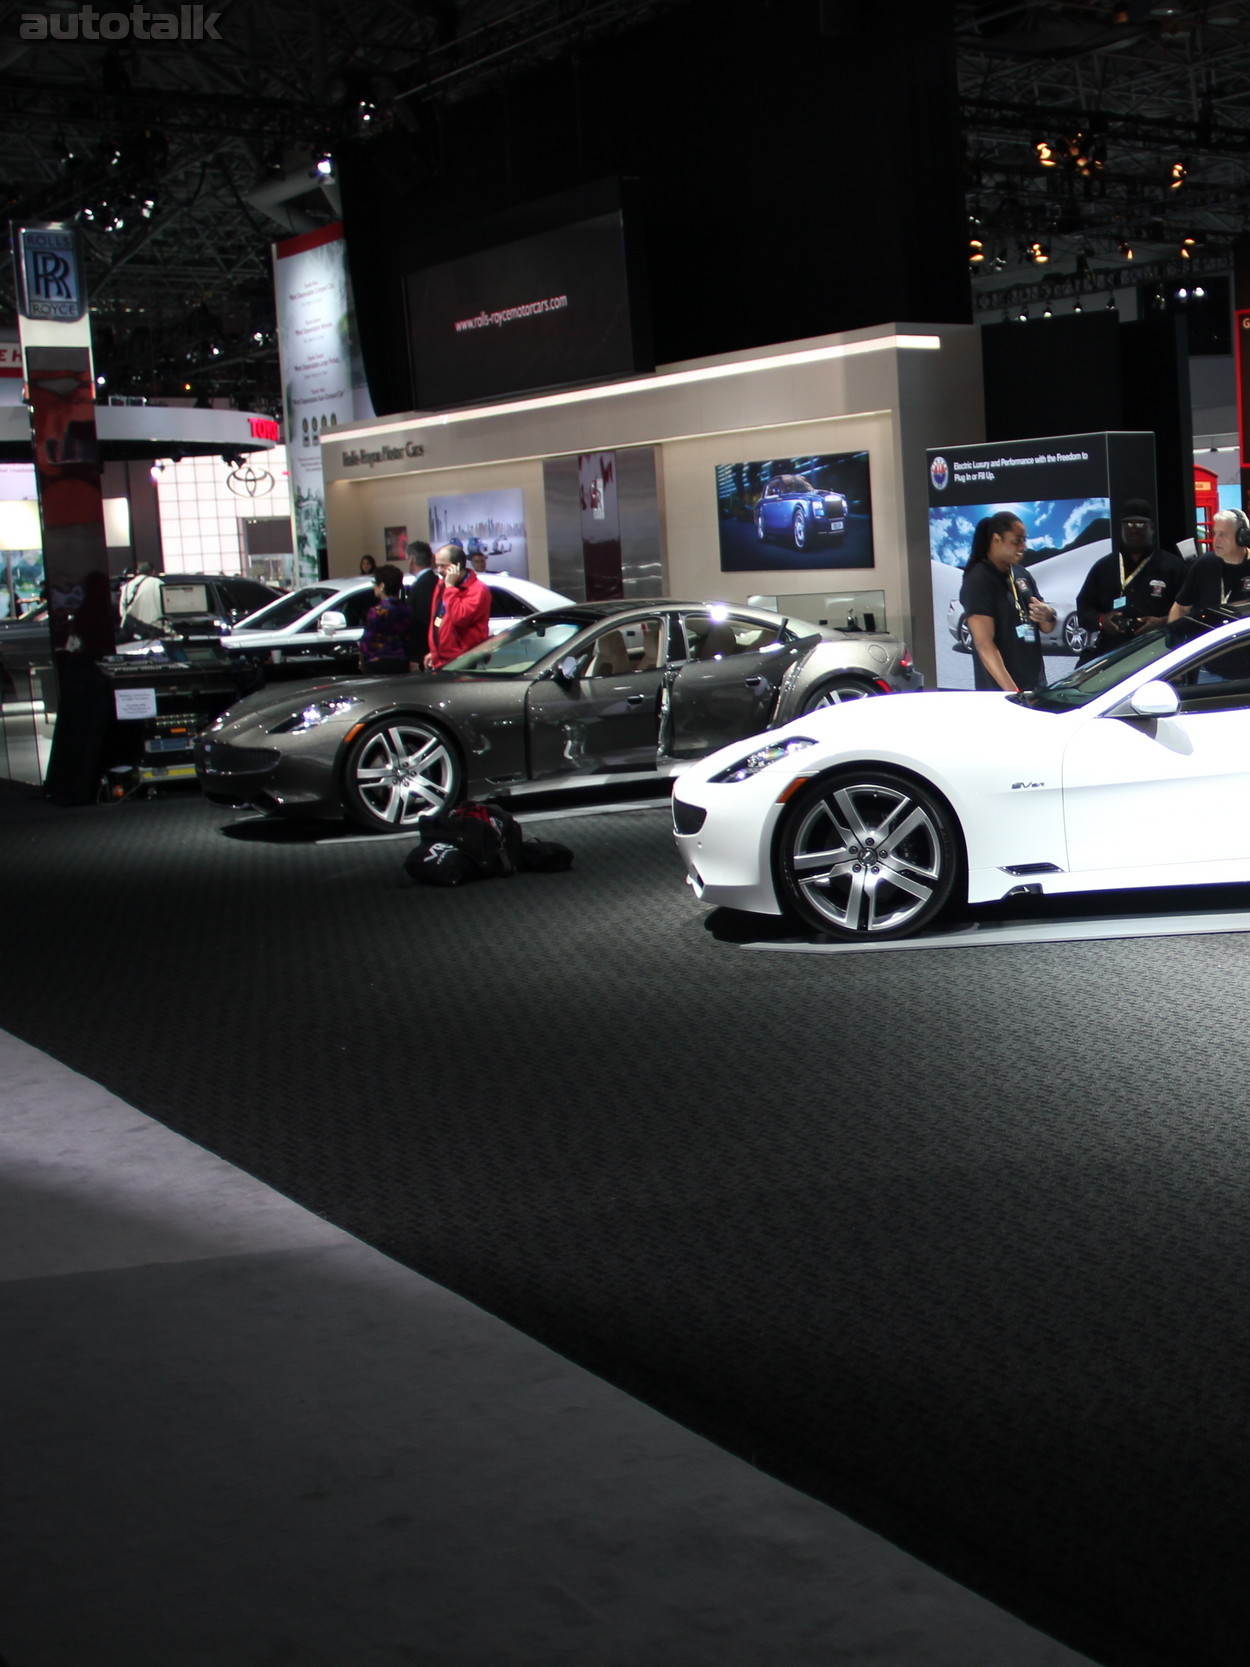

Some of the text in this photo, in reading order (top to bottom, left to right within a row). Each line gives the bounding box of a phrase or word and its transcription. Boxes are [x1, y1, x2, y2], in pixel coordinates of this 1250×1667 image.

[27, 234, 71, 247] ROLLS
[33, 303, 77, 316] ROYCE
[454, 294, 568, 332] www.rolls-roycemotorcars.com
[953, 461, 972, 470] Electric
[973, 460, 990, 470] Luxury
[991, 457, 1000, 468] and
[1001, 456, 1034, 467] Performance
[1035, 454, 1047, 464] with
[1047, 453, 1056, 463] the
[1057, 452, 1081, 462] Freedom
[1082, 450, 1089, 460] to
[954, 472, 966, 483] Plug
